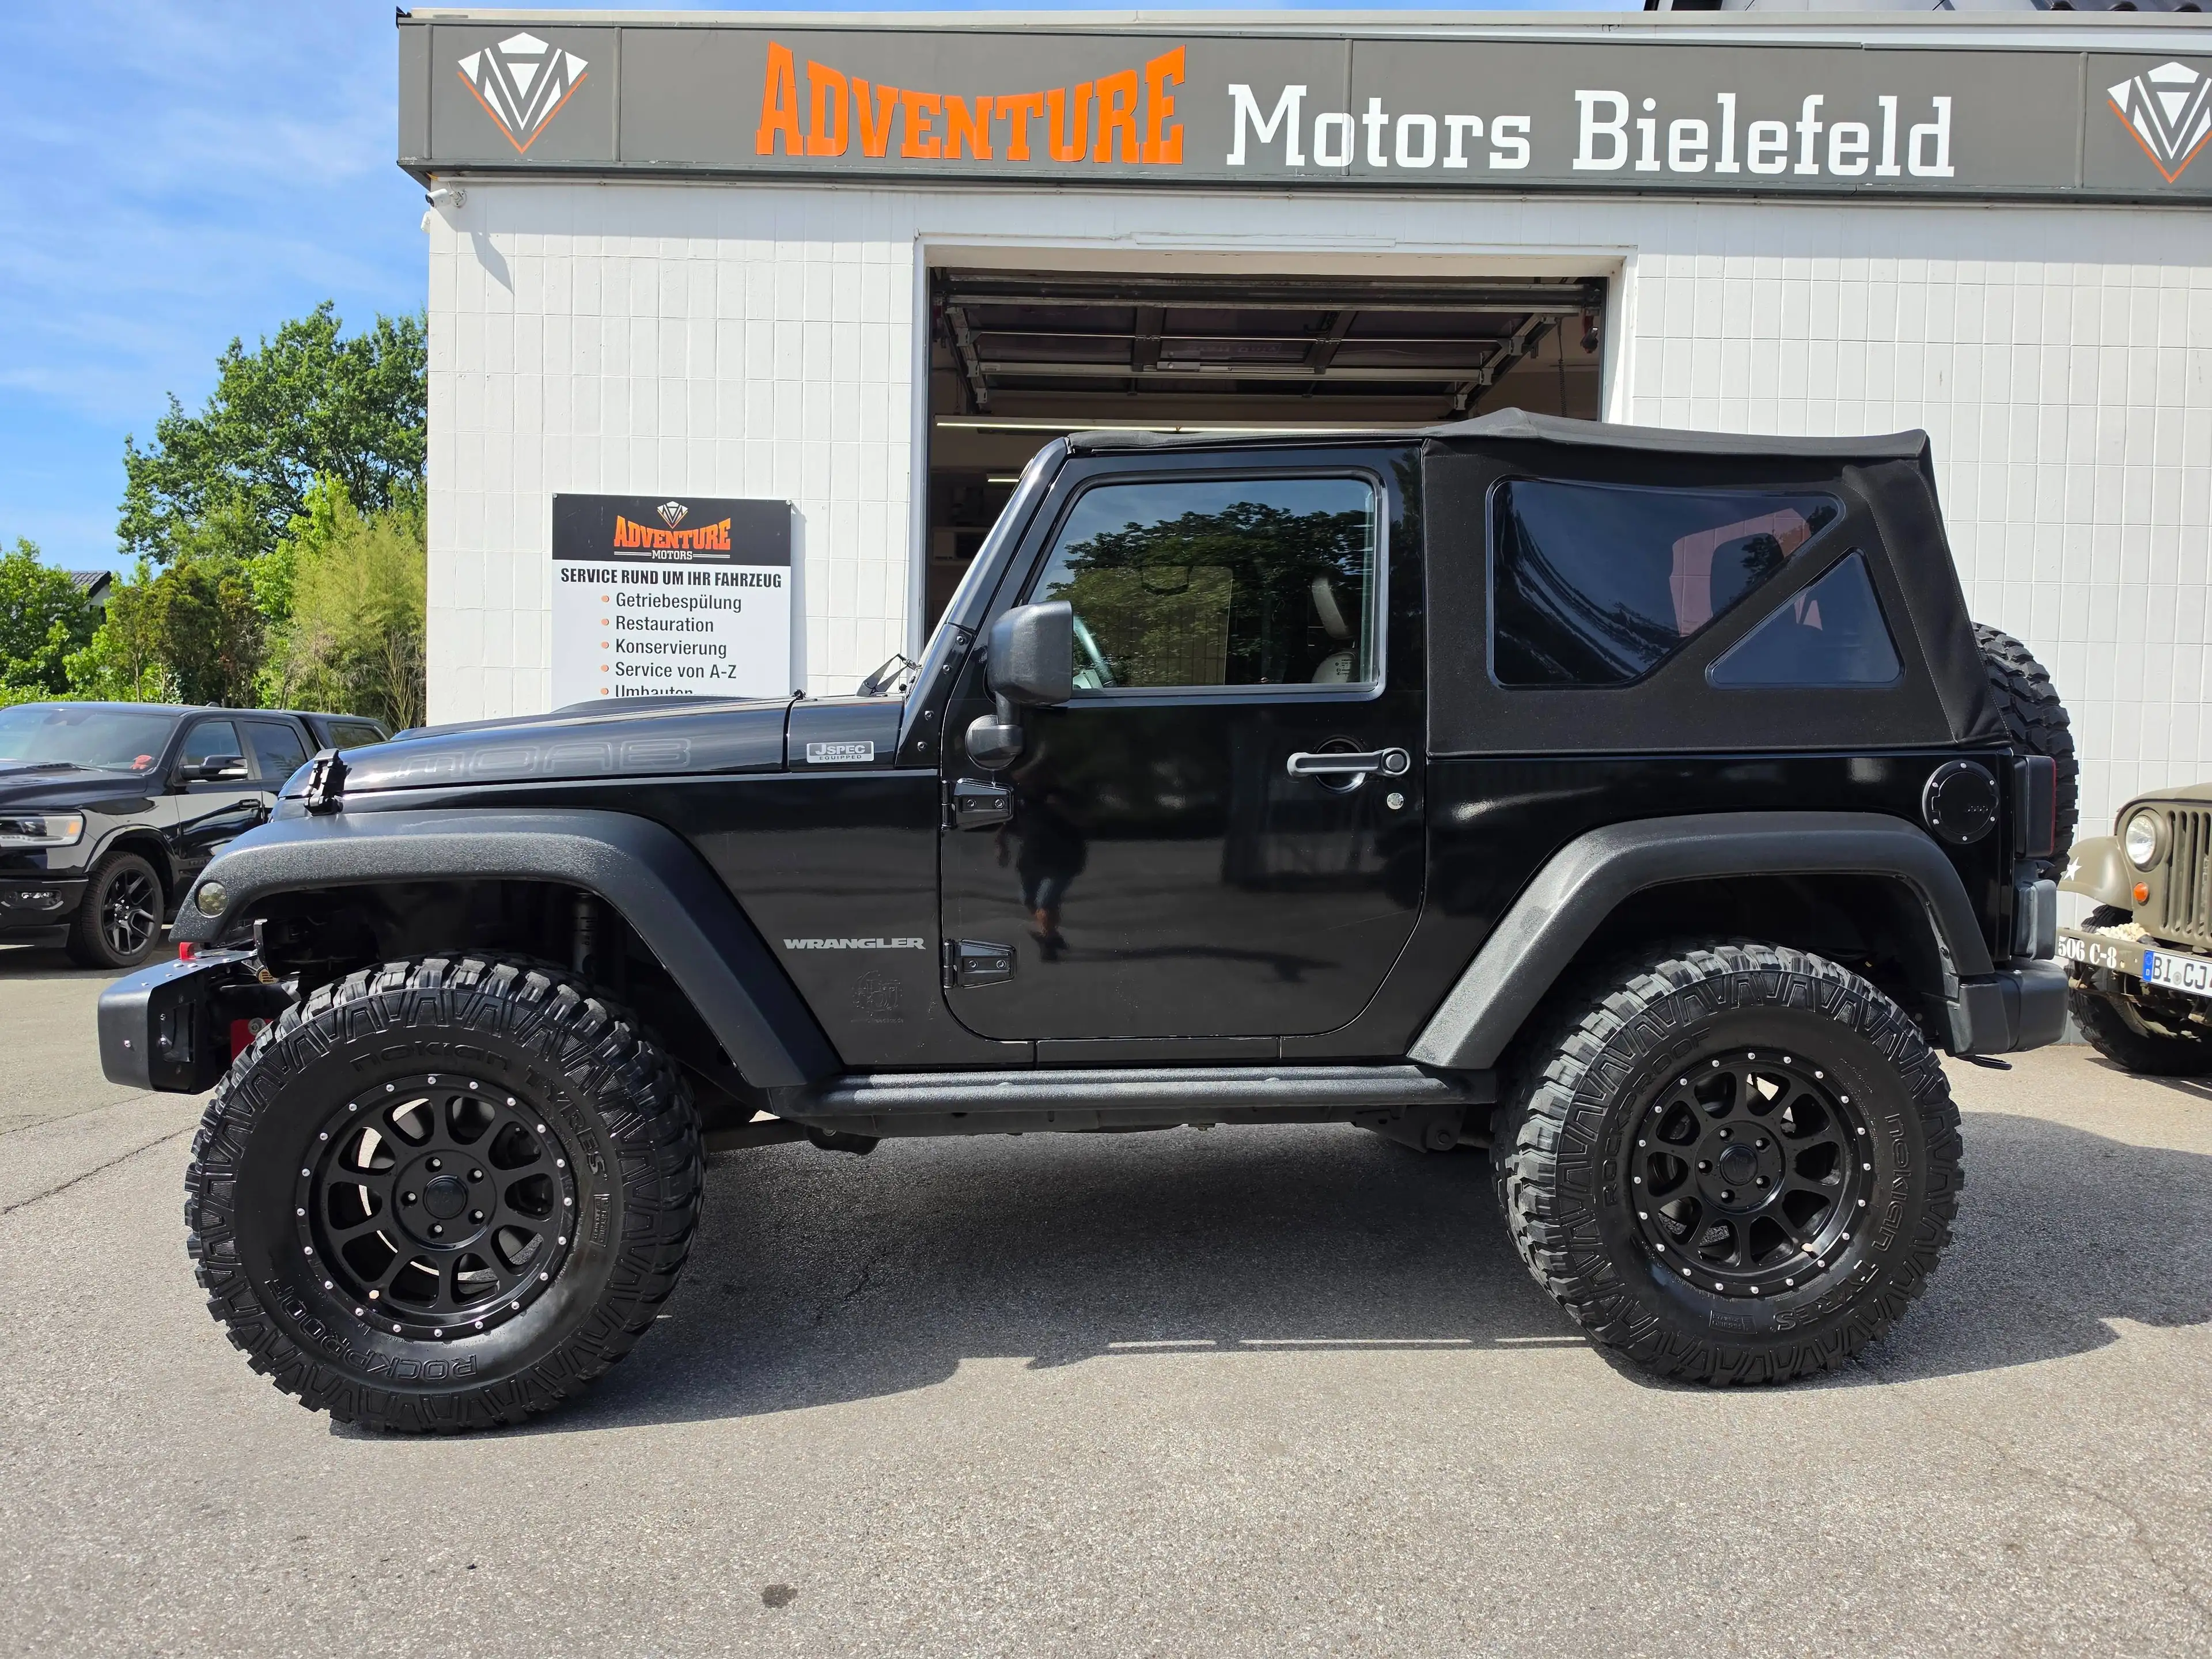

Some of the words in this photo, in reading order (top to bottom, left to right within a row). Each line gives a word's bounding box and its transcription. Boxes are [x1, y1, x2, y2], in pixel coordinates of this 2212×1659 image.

[755, 40, 1186, 164] ADVENTURE
[1226, 84, 1531, 169] Motors
[1573, 90, 1955, 177] Bielefeld
[614, 516, 730, 550] ADVENTURE
[652, 550, 693, 560] MOTORS
[561, 568, 618, 583] SERVICE
[622, 570, 658, 585] RUND
[662, 571, 684, 585] UM
[688, 571, 711, 586] IHR
[715, 572, 782, 588] FAHRZEUG
[616, 592, 742, 613] Getriebespülung
[616, 616, 714, 632] Restauration
[616, 638, 727, 659] Konservierung
[615, 662, 672, 677] Service
[677, 666, 704, 678] von
[710, 664, 737, 679] A-Z
[783, 938, 926, 950] WRANGLER
[2058, 936, 2085, 961] 506
[2089, 943, 2118, 969] C-8
[2145, 968, 2150, 976] D
[2153, 956, 2171, 983] BI
[2184, 963, 2207, 990] CJ
[525, 1064, 608, 1176] TYRES
[1602, 1029, 1712, 1207] ROCKPROOF
[1776, 1258, 1880, 1332] TYRES
[263, 1279, 478, 1381] ROCKPROOF
